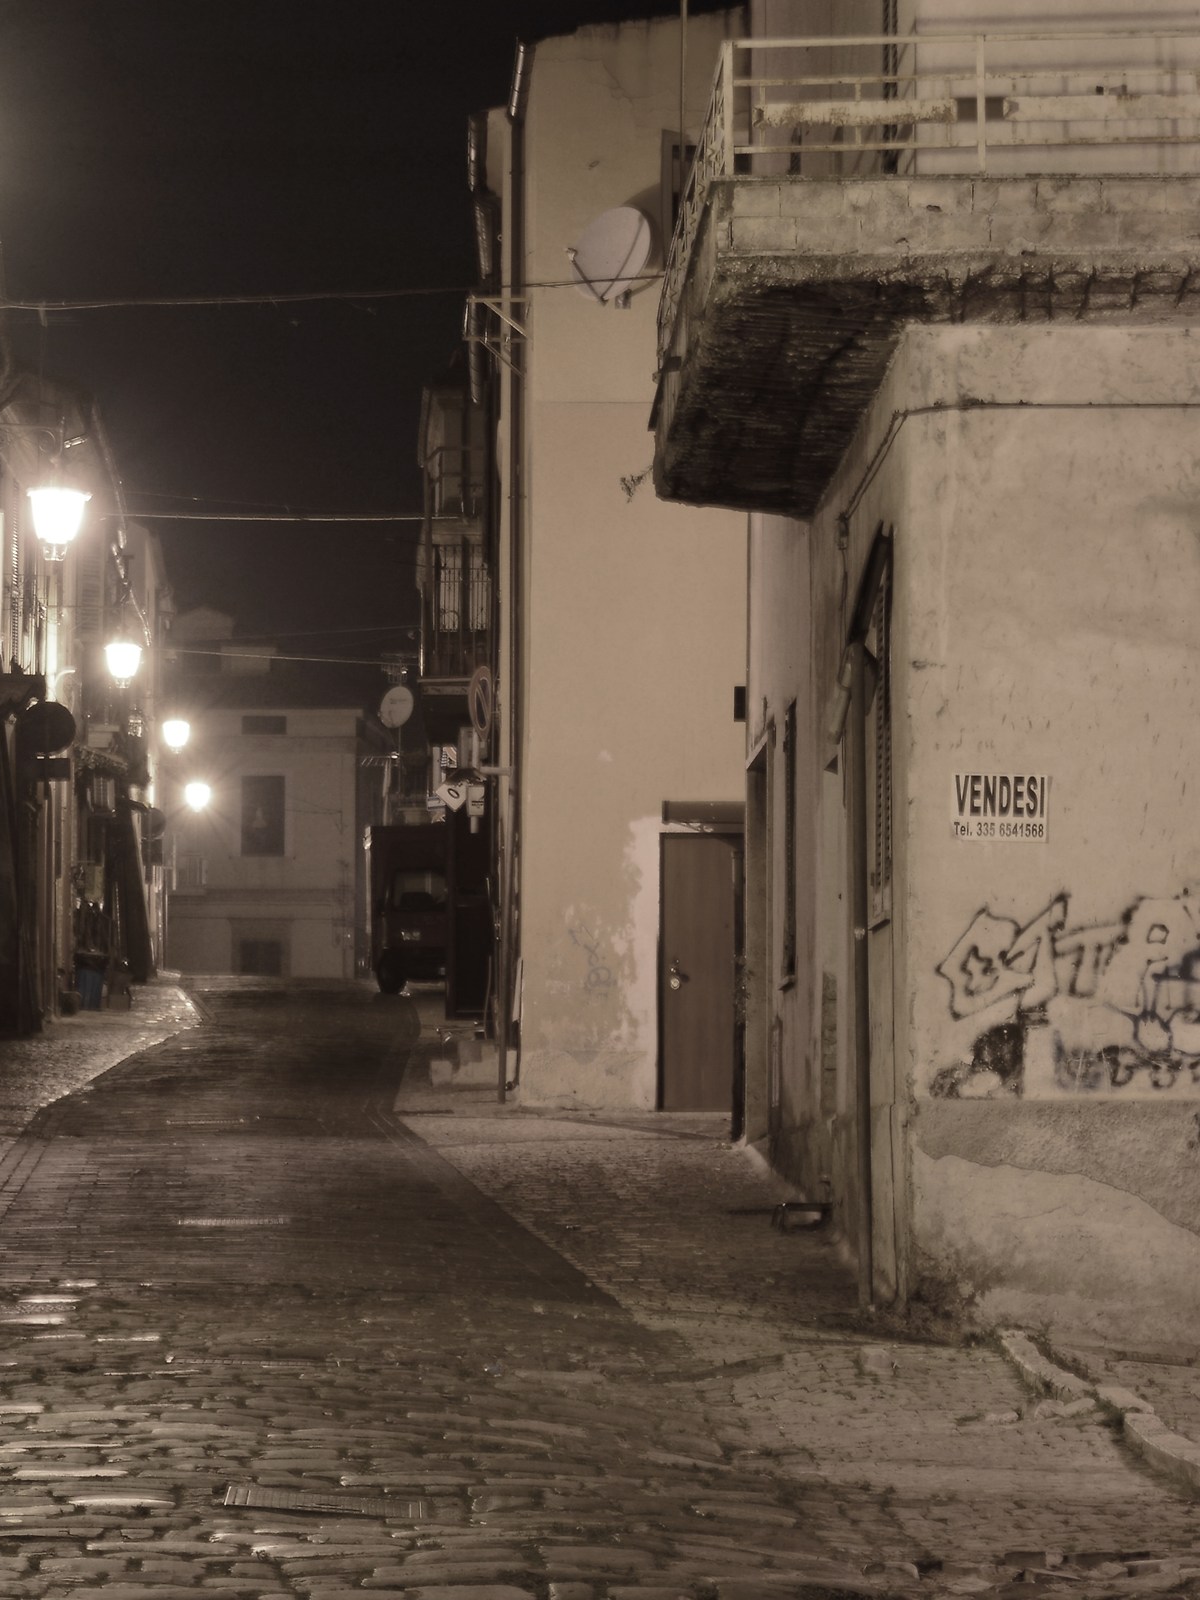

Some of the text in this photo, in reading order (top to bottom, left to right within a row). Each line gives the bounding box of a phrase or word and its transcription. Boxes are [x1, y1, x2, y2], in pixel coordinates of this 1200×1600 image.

[955, 775, 1045, 818] VENDESI
[954, 821, 1044, 838] Tel. 335 6541568
